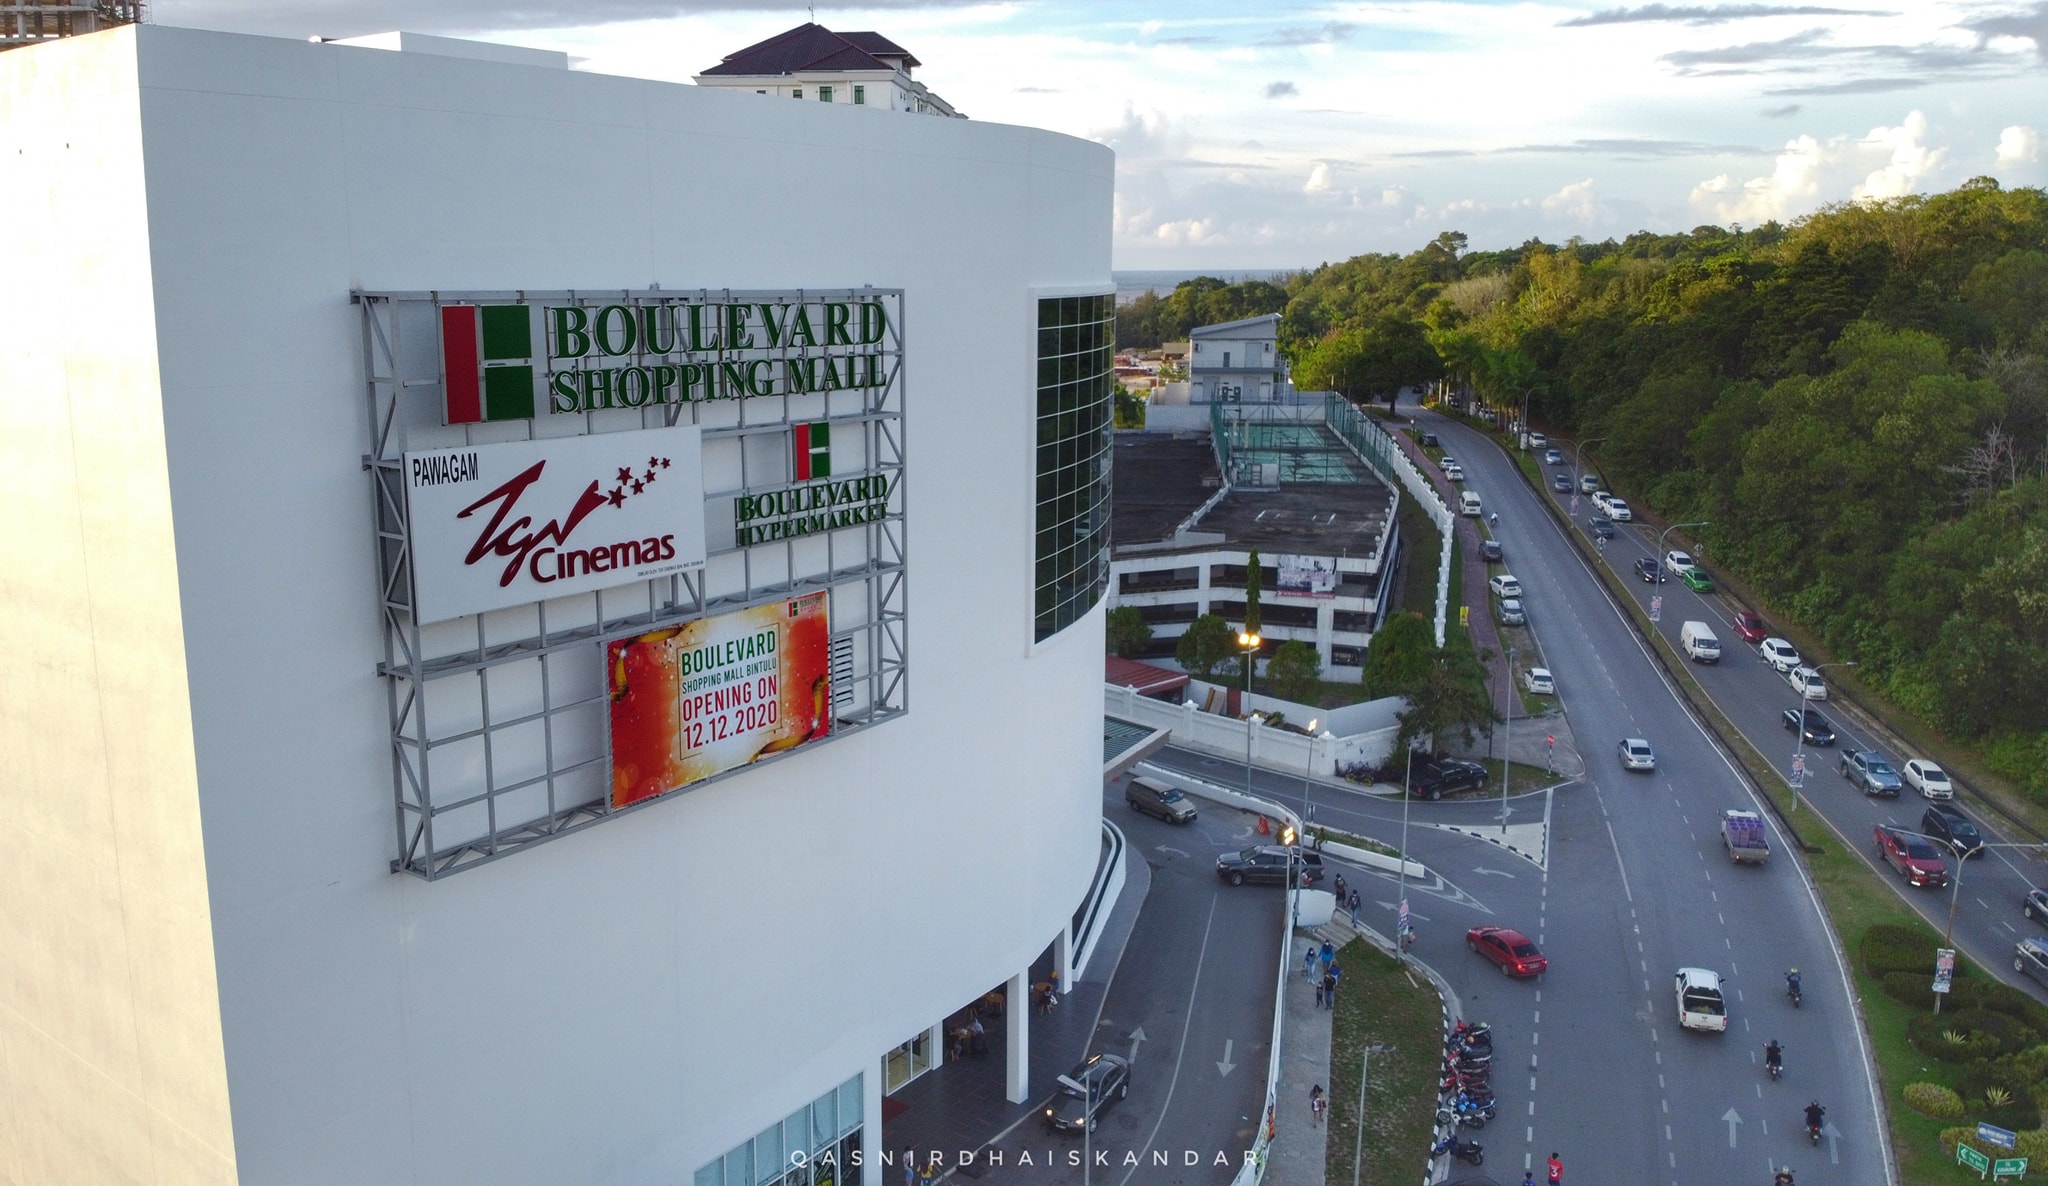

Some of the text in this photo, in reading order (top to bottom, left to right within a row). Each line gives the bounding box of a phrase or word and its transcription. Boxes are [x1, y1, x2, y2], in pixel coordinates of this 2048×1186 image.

[551, 301, 887, 359] BOULEVARD
[552, 353, 887, 413] SHOPPING MALL
[413, 452, 479, 487] PAWAGAM
[738, 474, 888, 522] BOULEVARD
[738, 502, 888, 547] HYPERMARKET
[529, 534, 676, 584] Cinemas
[681, 630, 776, 676] BOULEVARD
[682, 657, 777, 694] SHOPPING MALL BINTULU
[683, 674, 777, 721] OPENING ON
[683, 700, 777, 750] 12.12.2020
[1551, 1167, 1558, 1177] 3
